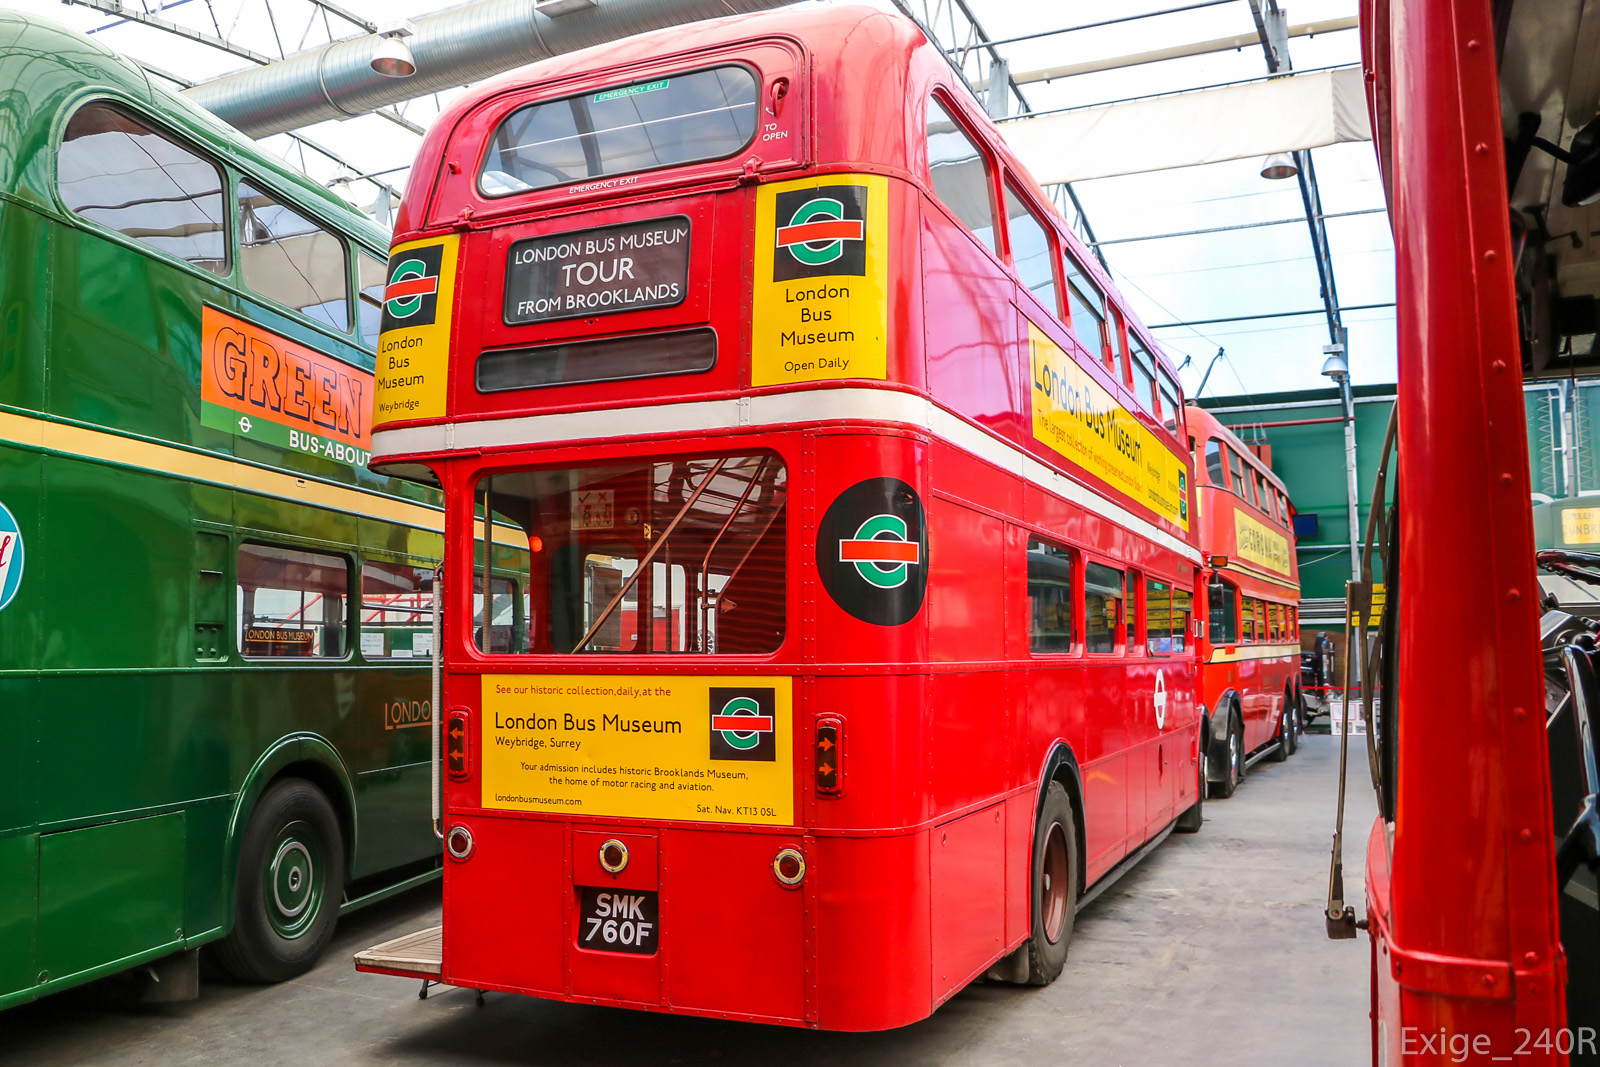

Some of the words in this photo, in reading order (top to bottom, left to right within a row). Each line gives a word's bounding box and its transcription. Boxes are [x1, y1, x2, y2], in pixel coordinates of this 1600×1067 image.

[598, 86, 646, 100] EMERGENCY
[646, 81, 665, 91] EXIT
[764, 122, 778, 132] TO
[762, 131, 788, 142] OPEN
[569, 180, 619, 195] EMERGENCY
[620, 176, 639, 187] EXIT
[515, 241, 581, 265] LONDON
[585, 237, 615, 255] BUS
[619, 228, 688, 251] MUSEUM
[562, 257, 635, 287] TOUR
[517, 296, 562, 316] FROM
[566, 282, 680, 310] BROOKLANDS
[786, 284, 850, 303] London
[801, 307, 832, 323] Bus
[382, 336, 423, 353] London
[781, 331, 855, 347] Museum
[388, 356, 410, 370] Bus
[784, 361, 815, 374] Open
[818, 357, 850, 370] Daily
[213, 326, 363, 439] GREEN
[377, 375, 425, 391] Museum
[379, 399, 420, 414] Weybridge
[1033, 340, 1083, 423] London
[1085, 385, 1105, 439] Bus
[1107, 405, 1143, 468] Museum
[289, 429, 373, 467] BUS-ABOUT
[244, 629, 275, 642] LONDON
[276, 631, 288, 641] BUS
[288, 632, 314, 643] MUSEUM
[495, 684, 512, 694] See
[513, 687, 528, 695] our
[530, 685, 564, 695] historic
[654, 686, 671, 697] the
[384, 699, 432, 731] LONDO
[495, 711, 557, 731] London
[564, 712, 596, 732] Bus
[602, 713, 682, 734] Museum
[495, 735, 547, 750] Weybridge,
[549, 737, 581, 751] Surrey
[520, 761, 538, 771] Your
[539, 763, 579, 773] admission
[581, 765, 617, 775] includes
[619, 765, 651, 776] historic
[654, 767, 704, 778] Brooklands
[707, 769, 749, 781] Museum,
[549, 776, 563, 785] the
[565, 777, 588, 786] home
[590, 777, 600, 786] of
[602, 779, 629, 788] motor
[630, 780, 656, 791] racing
[658, 781, 675, 790] and
[677, 782, 715, 792] aviation.
[495, 793, 583, 806] londonbusmuseum.com
[696, 803, 713, 814] Sat.
[715, 805, 734, 815] Nav.
[736, 806, 758, 816] KT13
[595, 892, 646, 920] SMK
[585, 917, 653, 946] 760F
